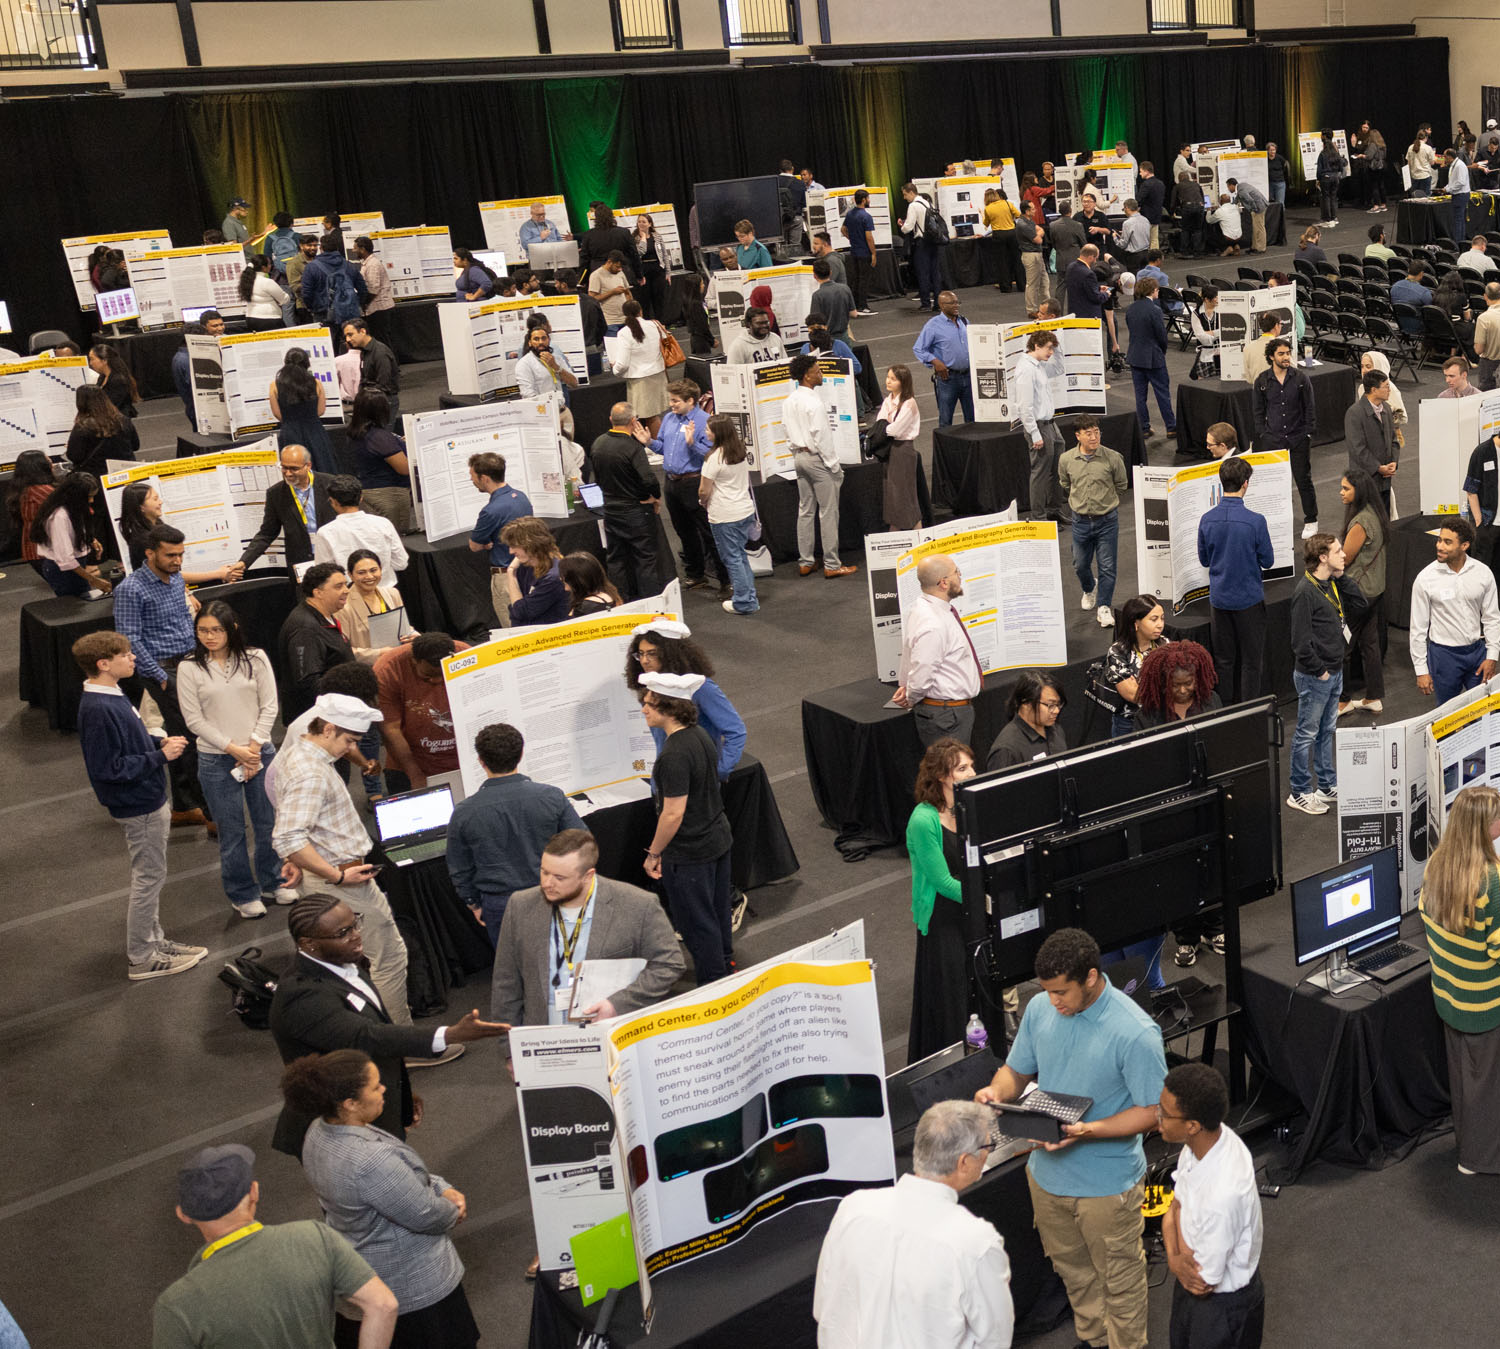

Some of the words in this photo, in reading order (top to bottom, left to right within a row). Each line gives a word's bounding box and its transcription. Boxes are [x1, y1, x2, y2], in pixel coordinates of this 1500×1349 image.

[457, 437, 487, 446] ASSURANT
[1146, 518, 1165, 526] Display
[937, 538, 960, 548] Interview
[962, 535, 973, 543] and
[974, 530, 1003, 540] Biography
[1005, 526, 1037, 534] Generation
[875, 592, 898, 600] Display
[496, 641, 530, 656] Cookly.io
[535, 632, 572, 646] Advanced
[573, 627, 600, 637] Recipe
[601, 622, 640, 632] Generator
[449, 656, 476, 673] UC-092
[1444, 713, 1470, 730] Environment
[1469, 705, 1488, 717] Dynamic
[1346, 836, 1382, 847] Tri-Fold
[1414, 825, 1427, 840] oard
[657, 1012, 701, 1028] Center,
[703, 1007, 718, 1017] do
[720, 999, 739, 1017] you
[740, 977, 769, 1003] copy?"
[657, 1032, 713, 1051] "Command
[716, 1020, 746, 1036] Center,
[746, 1011, 755, 1021] do
[755, 1002, 770, 1017] you
[770, 991, 802, 1009] copy?"
[803, 990, 812, 1000] is
[822, 992, 842, 1002] sci-fi
[520, 1040, 540, 1048] Bring
[654, 1050, 692, 1067] themed
[695, 1038, 731, 1057] survival
[732, 1028, 754, 1044] horror
[755, 1016, 776, 1033] game
[778, 1005, 807, 1019] where
[809, 1003, 842, 1015] players
[656, 1064, 681, 1080] must
[683, 1058, 714, 1074] sneak
[716, 1044, 745, 1065] around
[746, 1036, 759, 1052] and
[759, 1024, 778, 1044] fend
[779, 1018, 791, 1031] off
[792, 1017, 806, 1026] an
[808, 1015, 829, 1026] alien
[831, 1014, 847, 1026] like
[536, 1046, 599, 1056] www.elmers.com
[658, 1077, 692, 1095] enemy
[694, 1071, 721, 1089] using
[723, 1059, 742, 1076] their
[775, 1030, 799, 1048] while
[801, 1028, 821, 1038] also
[823, 1028, 849, 1041] trying
[659, 1096, 670, 1107] to
[672, 1090, 691, 1104] find
[693, 1086, 710, 1099] the
[712, 1077, 734, 1096] parts
[735, 1061, 761, 1084] needed
[761, 1052, 770, 1063] to
[771, 1048, 782, 1060] fix
[784, 1042, 806, 1054] their
[661, 1090, 739, 1120] communications
[740, 1072, 764, 1094] system
[765, 1064, 774, 1075] to
[774, 1060, 791, 1073] call
[792, 1054, 806, 1065] for
[807, 1054, 831, 1066] help.
[531, 1124, 573, 1137] Display
[574, 1122, 610, 1133] Board
[689, 1239, 709, 1248] Miller,
[722, 1224, 742, 1235] Hardy,
[671, 1246, 703, 1261] Professor
[703, 1237, 728, 1250] Murphy
